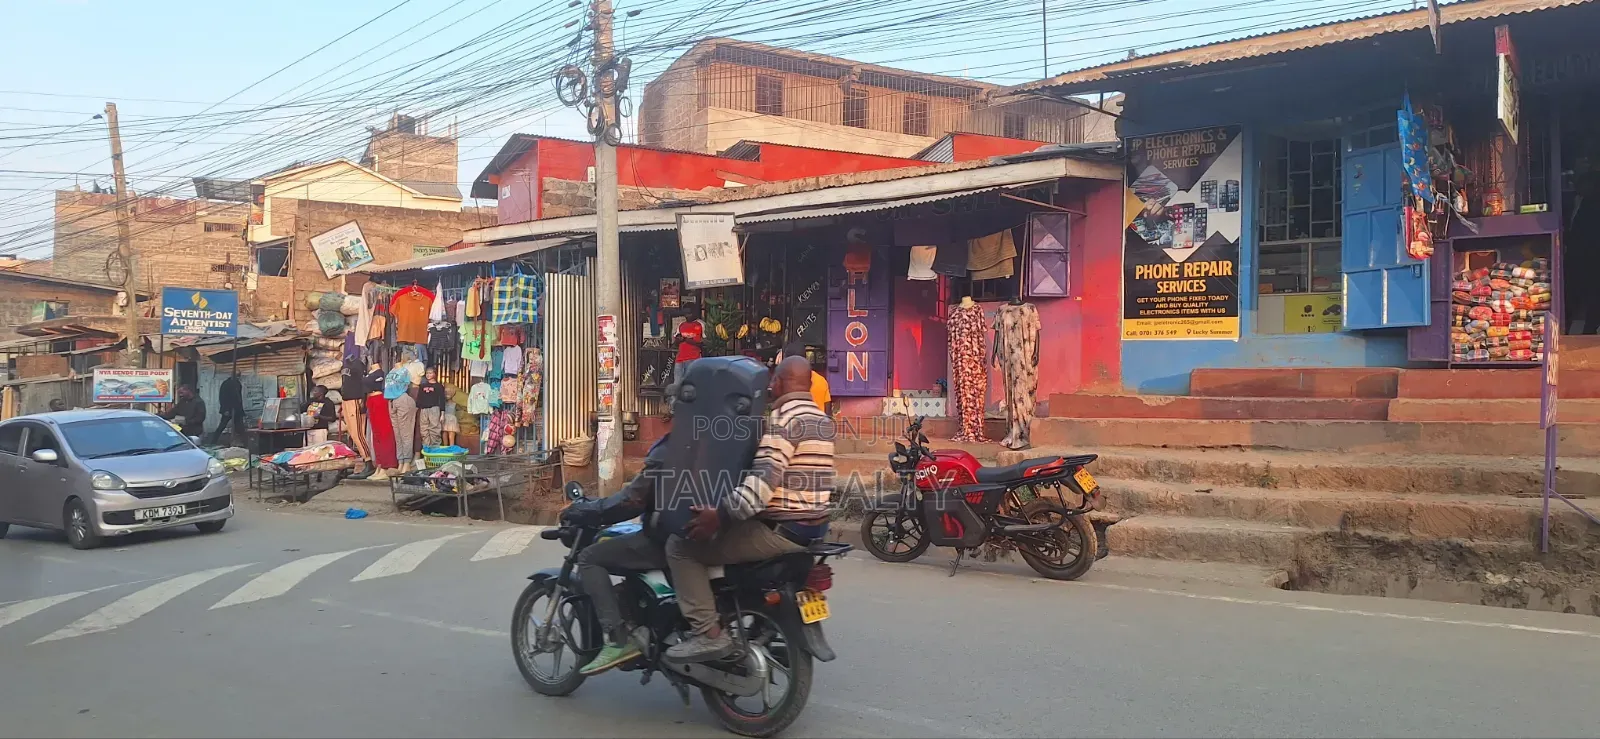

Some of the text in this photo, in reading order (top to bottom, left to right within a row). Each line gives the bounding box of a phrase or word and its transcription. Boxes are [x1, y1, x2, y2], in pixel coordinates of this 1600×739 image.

[1145, 129, 1214, 149] ELECTRONICS
[1217, 128, 1227, 140] &
[1147, 142, 1217, 160] PHONE REPAIR
[1163, 158, 1199, 170] SERVICES
[1135, 260, 1233, 280] PHONE REPAIR
[1156, 279, 1207, 293] SERVICES
[164, 307, 233, 320] SEVENTH-DAY
[170, 317, 231, 328] ADVENTIST
[796, 312, 817, 338] FRUITS
[915, 464, 938, 480] spiro
[162, 505, 184, 516] 739J
